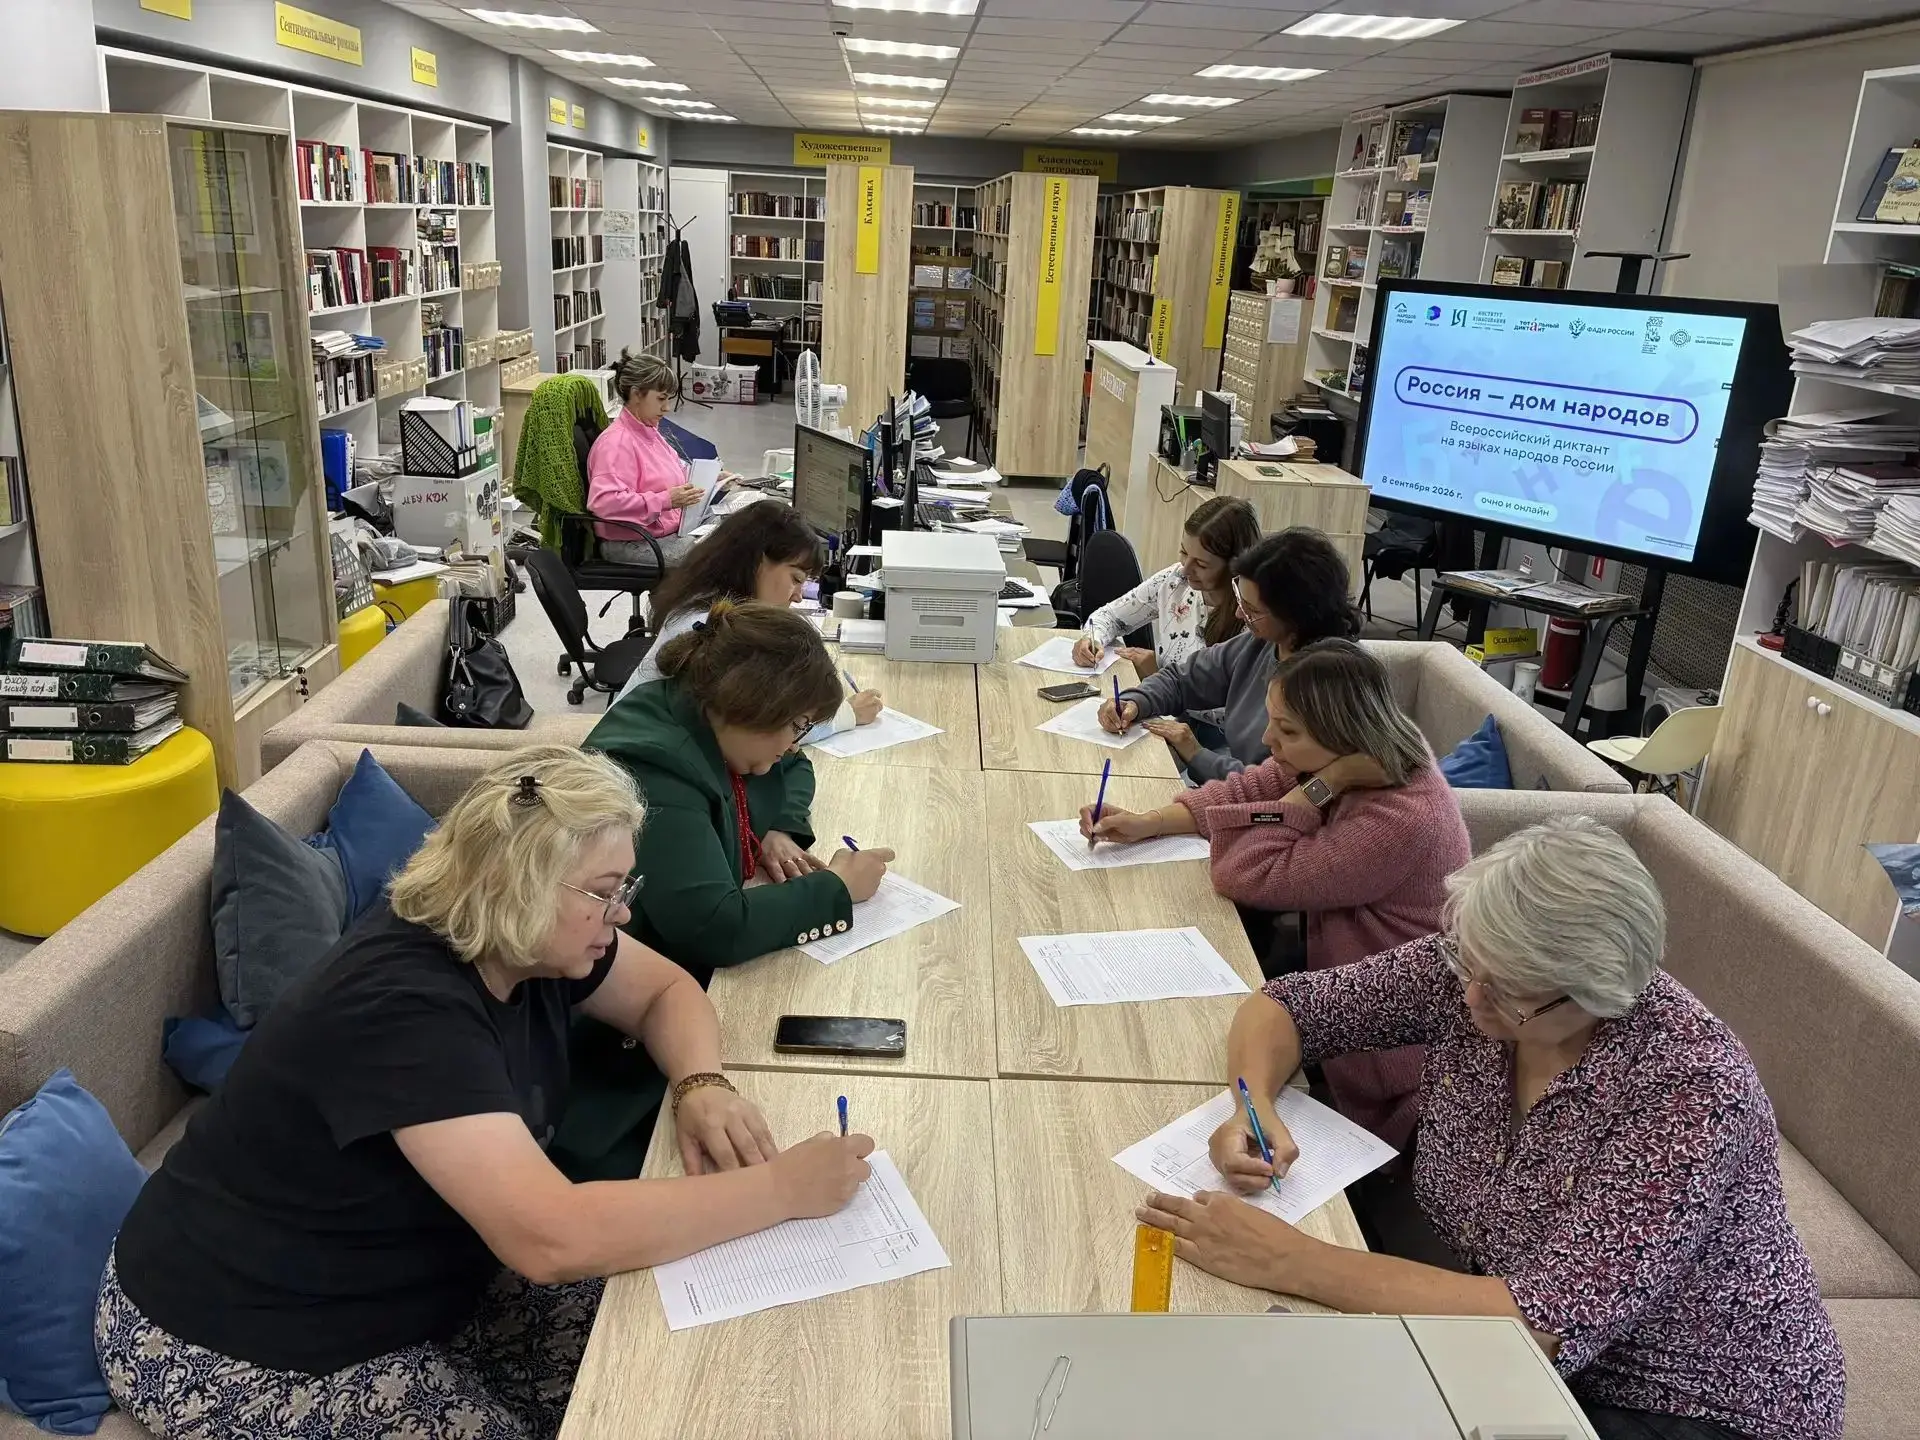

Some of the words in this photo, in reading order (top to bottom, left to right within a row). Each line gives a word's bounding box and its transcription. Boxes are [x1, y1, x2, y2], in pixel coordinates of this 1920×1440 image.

[279, 15, 337, 46] Сентиментальные
[336, 38, 359, 52] романы
[800, 139, 882, 153] Художественная
[813, 150, 870, 162] литература
[1037, 154, 1104, 167] Классическая
[1051, 182, 1061, 211] науки
[1222, 197, 1233, 224] науки
[1045, 214, 1059, 284] Естественные
[1215, 223, 1231, 287] Медицинские
[1158, 303, 1167, 329] науки
[1607, 328, 1635, 336] РОССИИ
[317, 387, 324, 400] Н
[338, 385, 344, 396] О
[1407, 375, 1481, 402] Россия
[1510, 393, 1556, 412] дом
[1563, 400, 1671, 428] народов
[1450, 420, 1550, 447] Всероссийский
[1553, 437, 1610, 456] диктант
[1440, 435, 1456, 447] на
[1458, 440, 1501, 455] языках
[1503, 447, 1559, 466] народов
[1562, 455, 1615, 474] России
[1381, 475, 1388, 485] 8
[1389, 478, 1430, 494] сентября
[1432, 485, 1455, 499] 2026
[1456, 491, 1464, 500] г.
[1481, 496, 1504, 509] очно
[1505, 501, 1512, 509] и
[1513, 503, 1551, 517] онлайн
